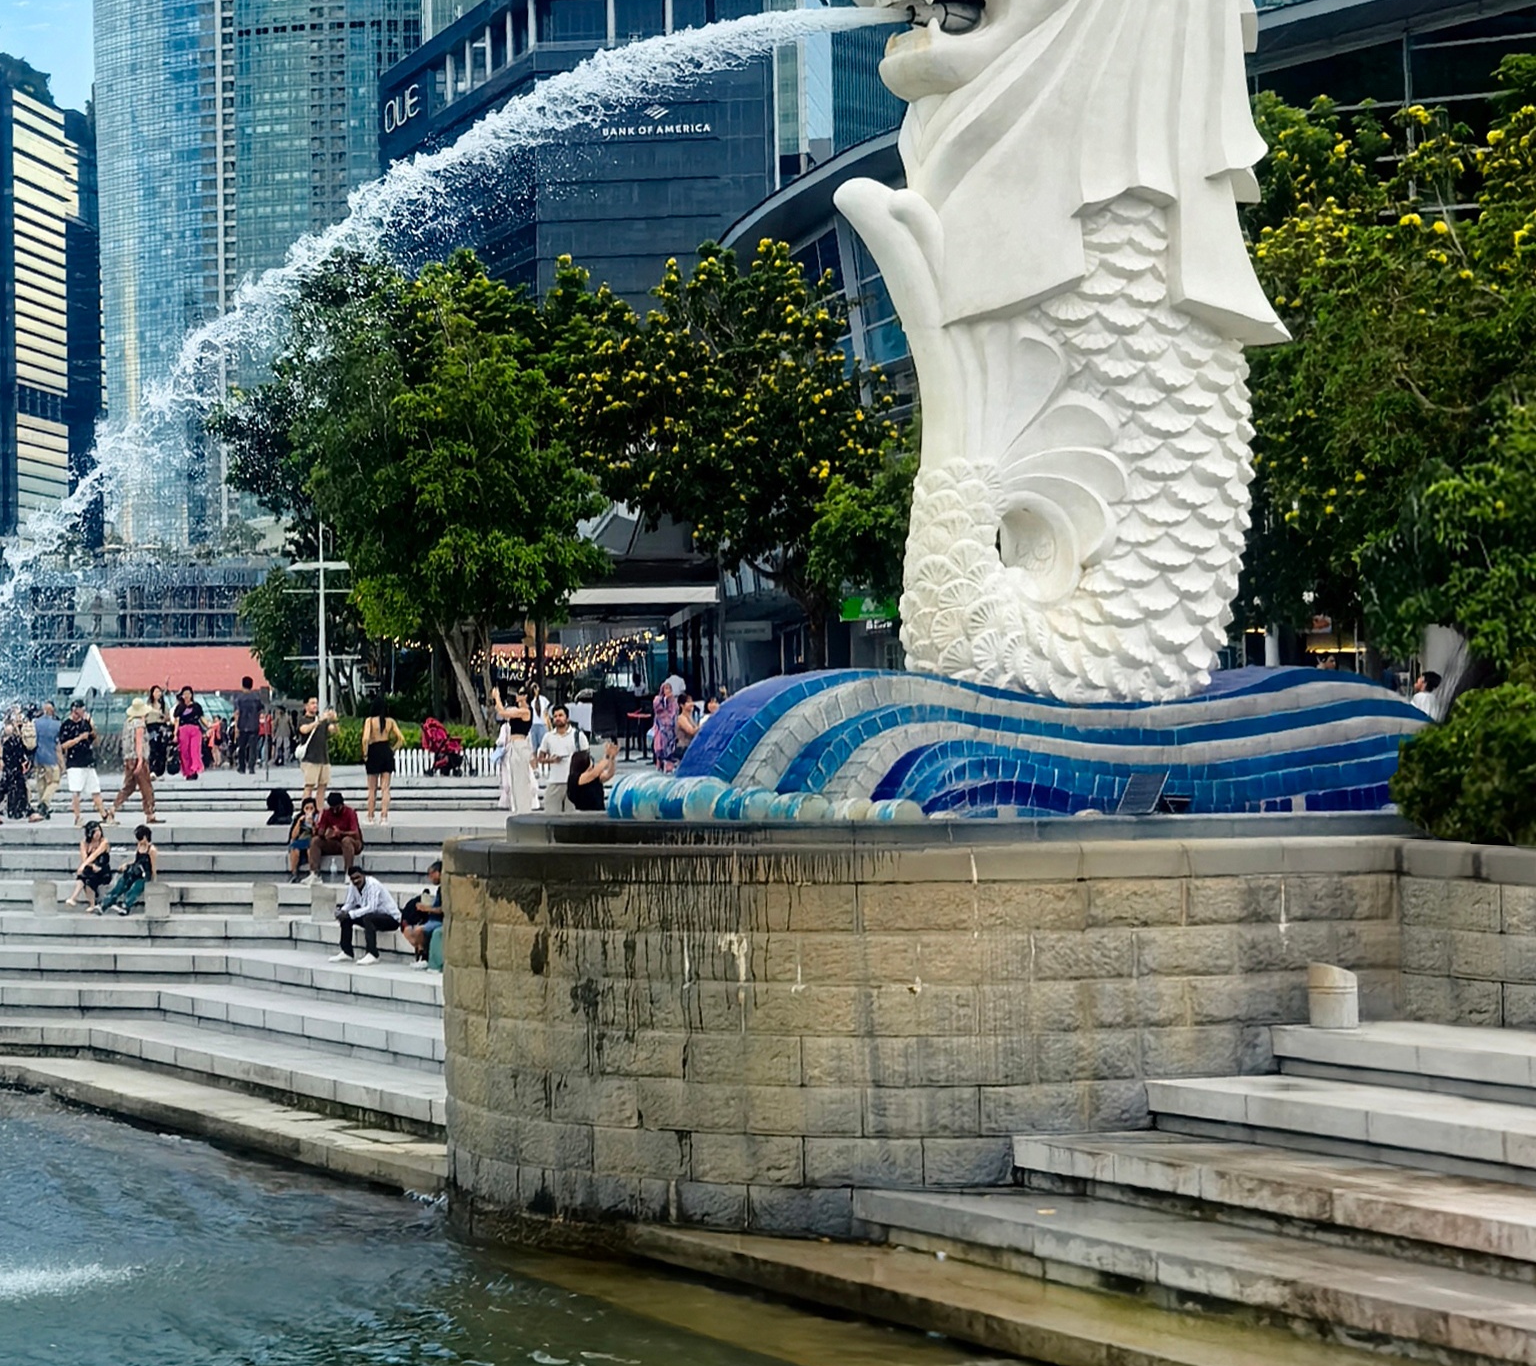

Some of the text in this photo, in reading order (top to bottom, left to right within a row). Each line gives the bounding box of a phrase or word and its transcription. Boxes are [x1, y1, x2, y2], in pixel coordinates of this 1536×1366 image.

[384, 83, 420, 134] OUE
[638, 125, 653, 135] OF
[656, 122, 711, 135] AMERICA
